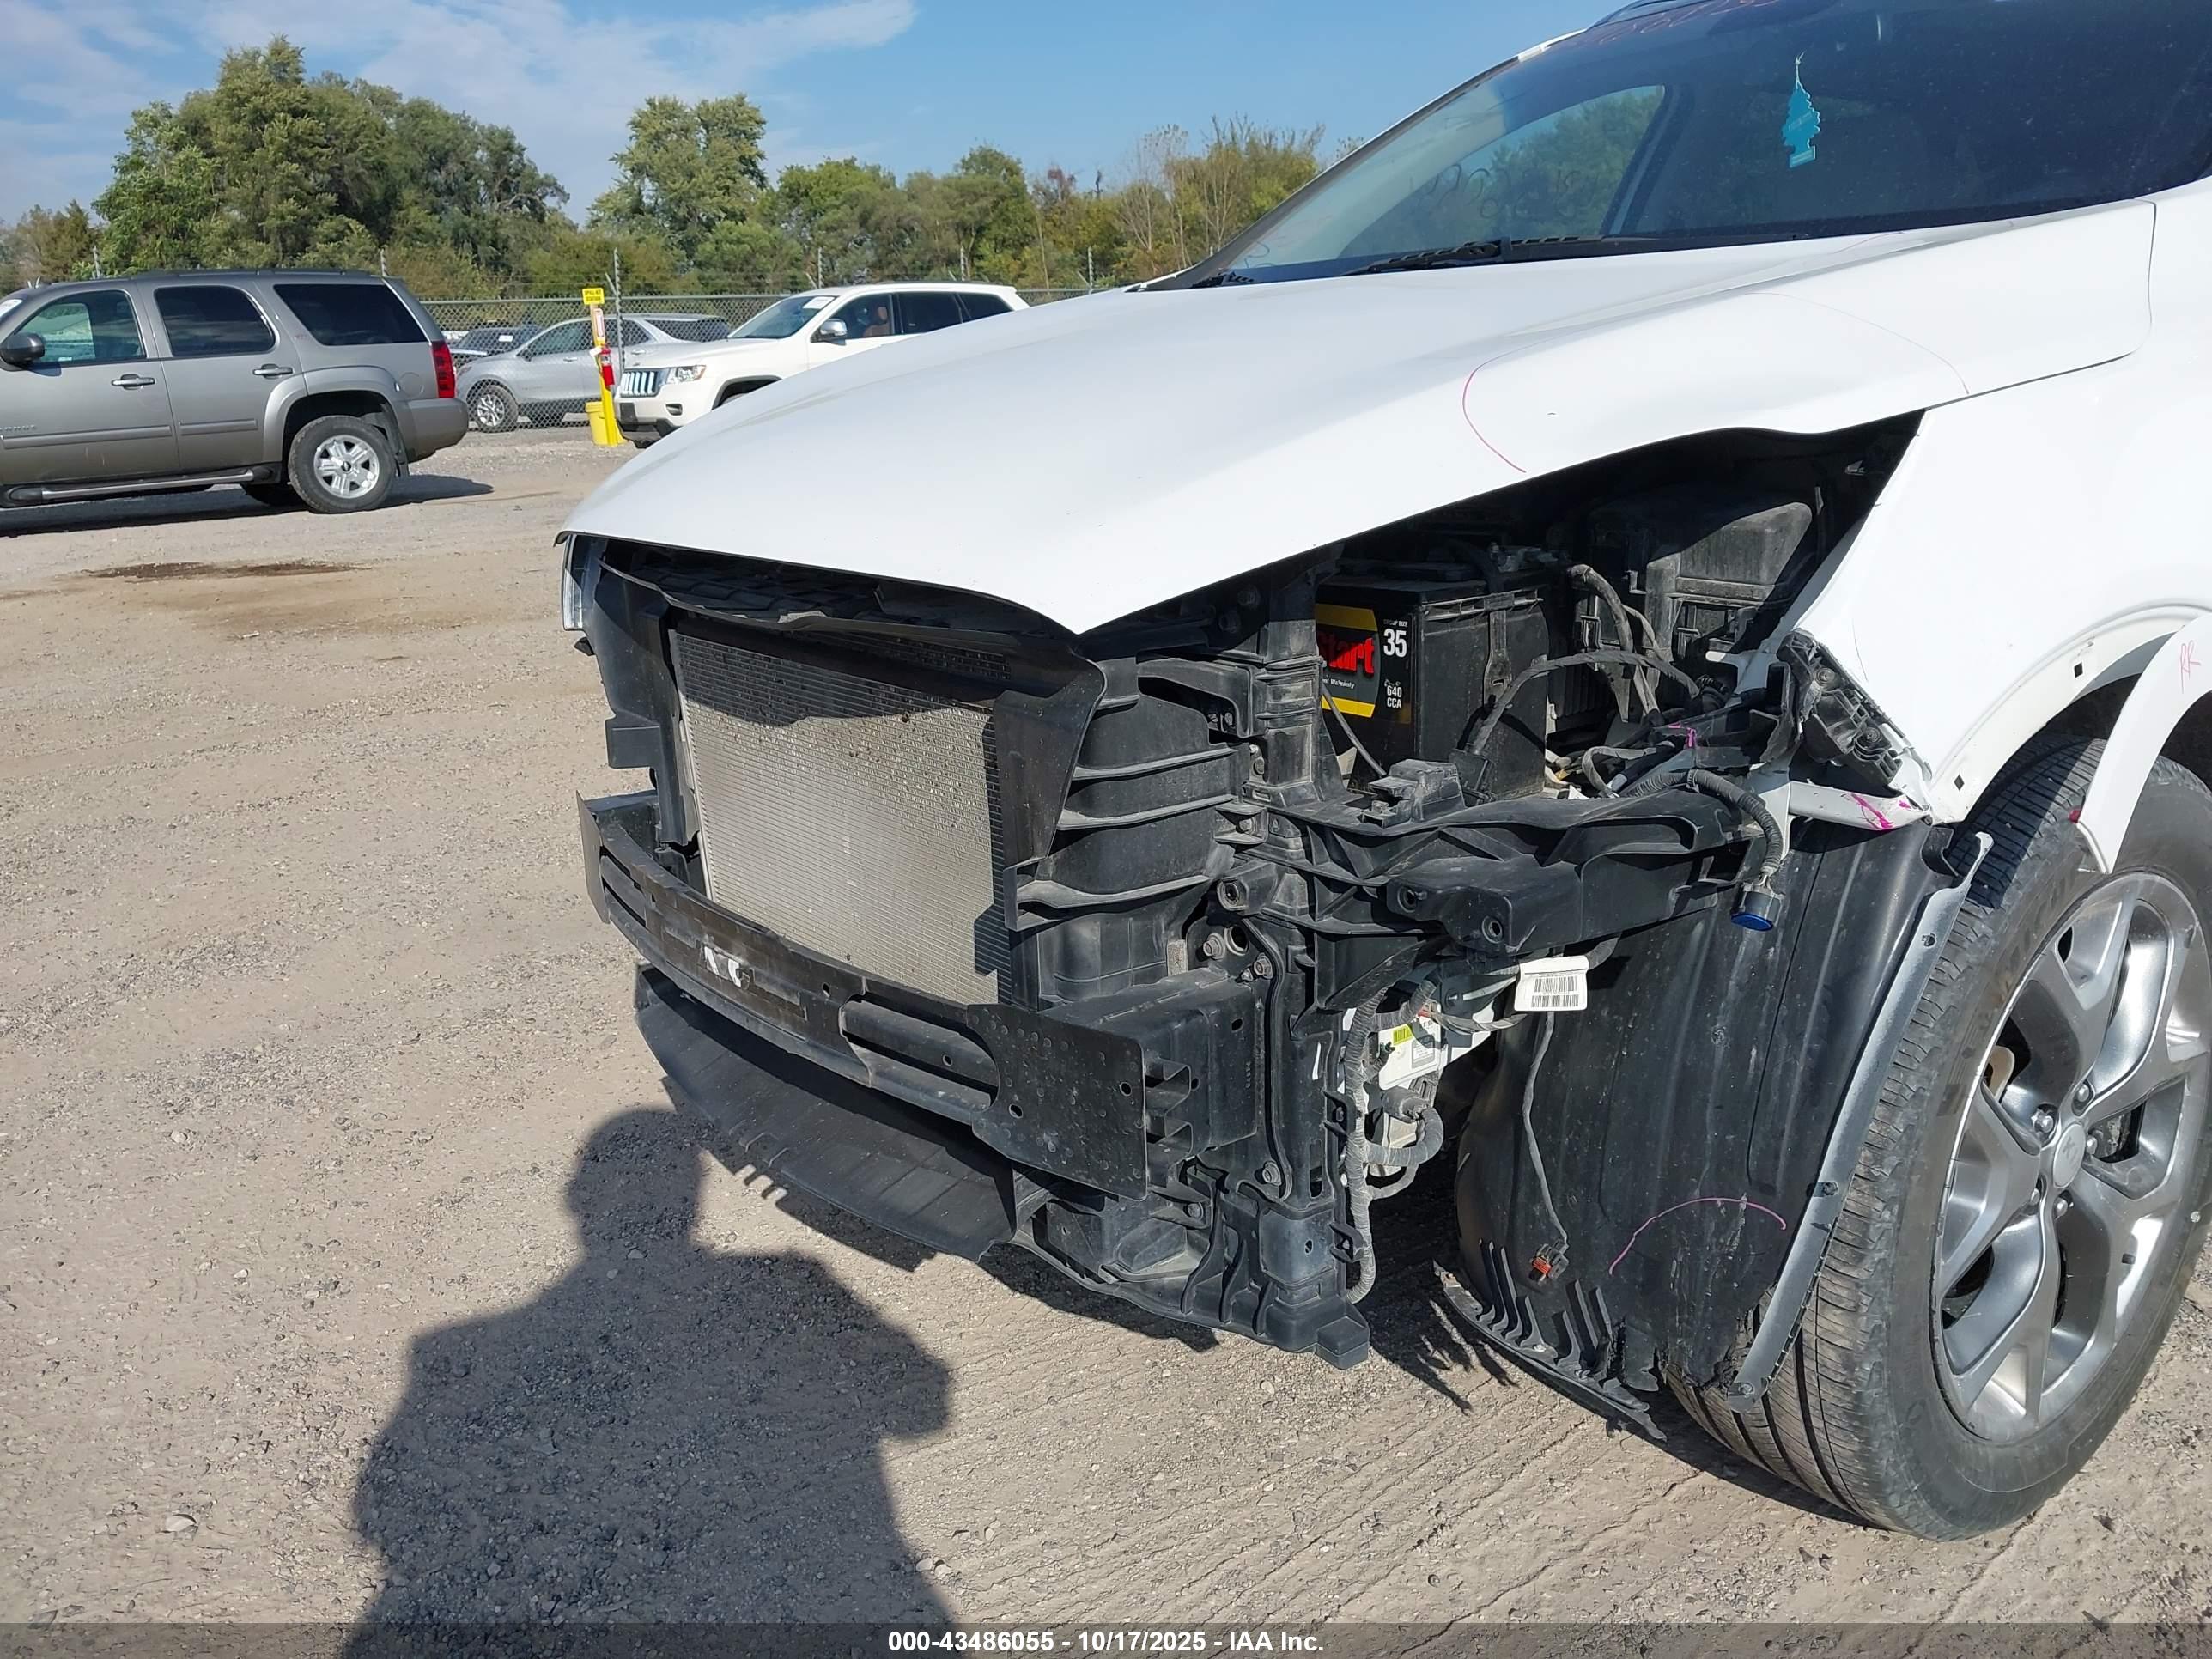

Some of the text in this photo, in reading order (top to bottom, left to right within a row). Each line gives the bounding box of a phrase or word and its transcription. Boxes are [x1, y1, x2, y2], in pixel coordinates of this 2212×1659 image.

[1383, 628, 1407, 658] 35
[1387, 685, 1402, 698] 640
[1387, 696, 1402, 709] CCA
